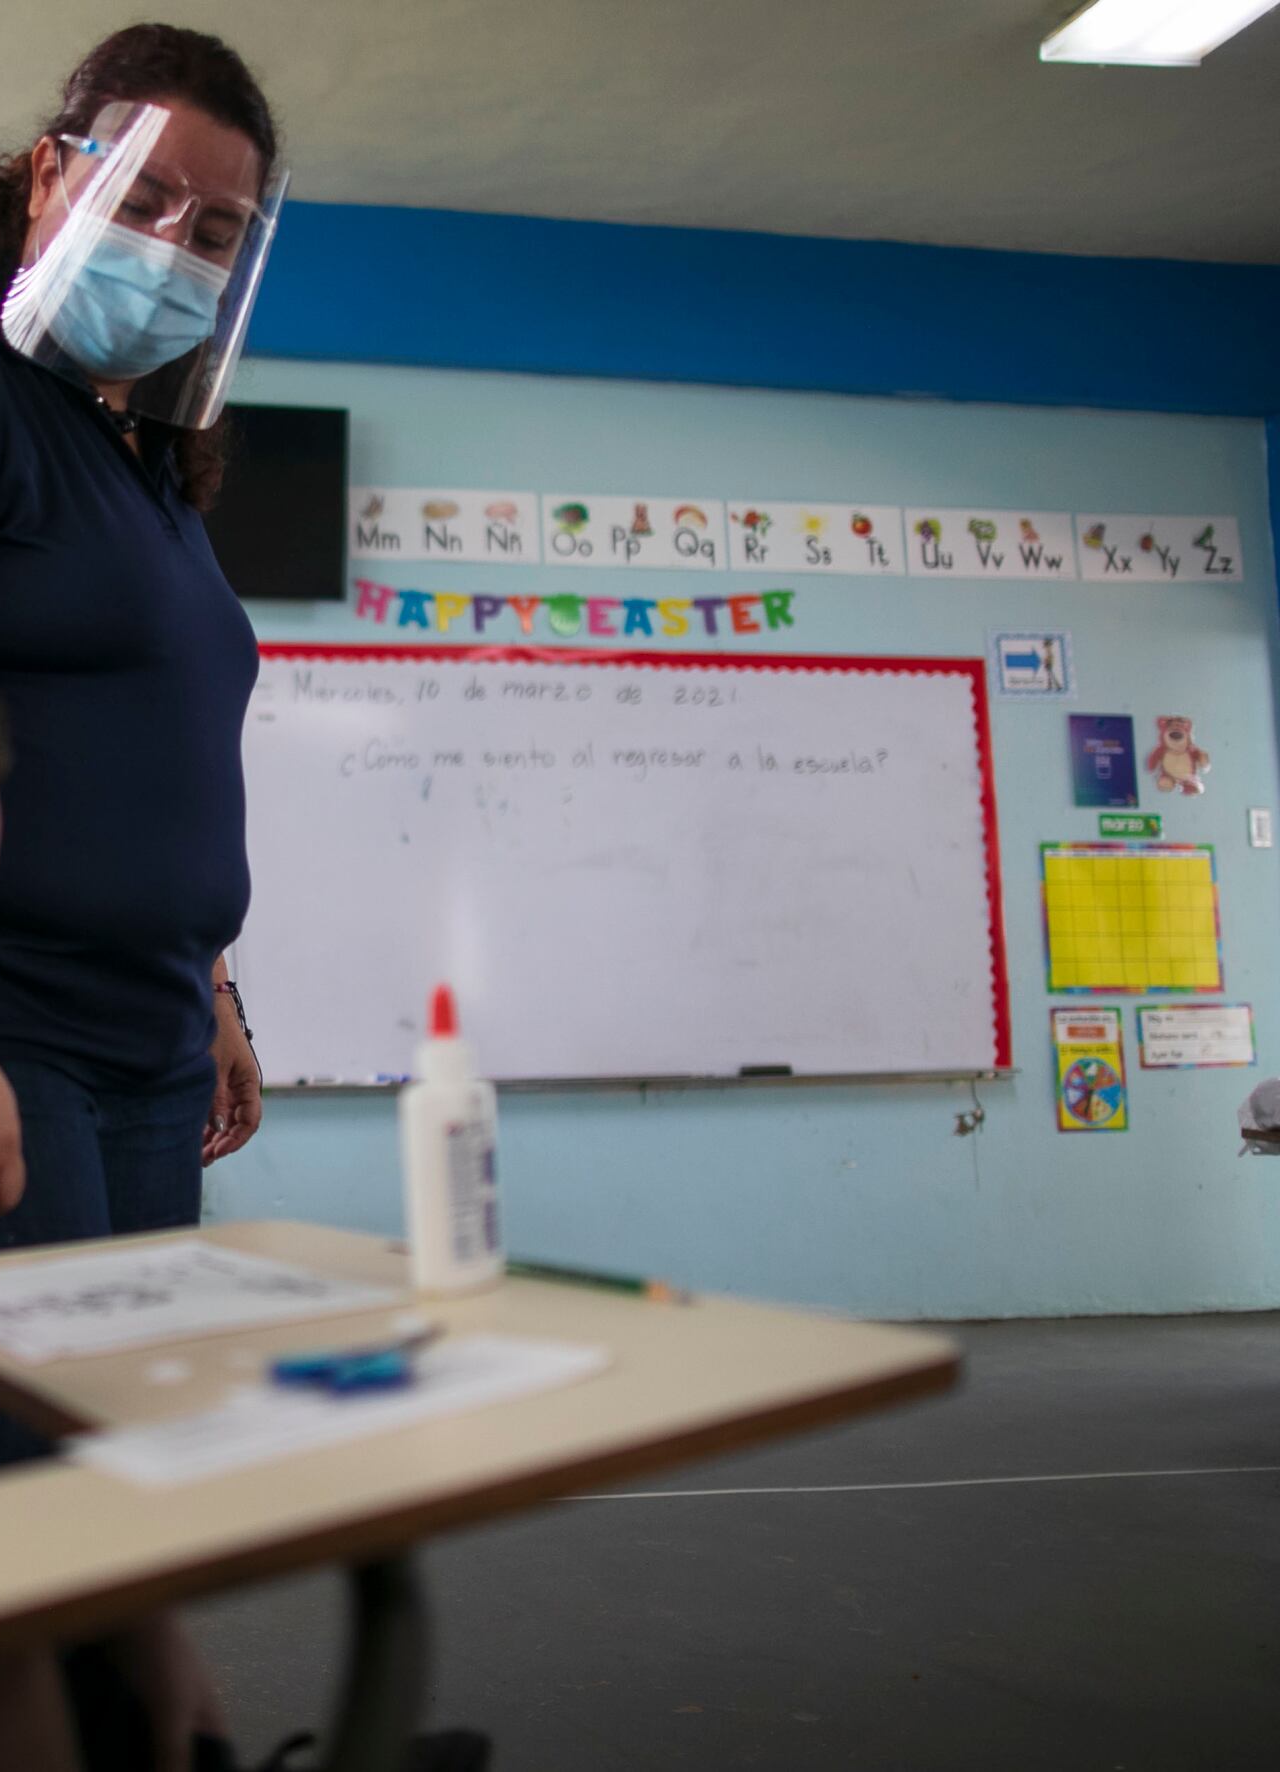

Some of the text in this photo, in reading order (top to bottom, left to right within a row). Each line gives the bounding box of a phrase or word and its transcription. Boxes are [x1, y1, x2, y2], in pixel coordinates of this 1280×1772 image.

[356, 524, 401, 551] Mm
[425, 524, 462, 552] Nn
[552, 531, 593, 558] Oo
[612, 525, 642, 563] Pp
[674, 530, 717, 566] Qq
[744, 536, 770, 563] Rr
[806, 537, 832, 565] Ss
[866, 537, 889, 567] Tt
[921, 542, 954, 570] Uu
[976, 542, 1005, 570] Vv
[1019, 544, 1062, 571] Ww
[1104, 545, 1132, 572] Xx
[1155, 546, 1180, 578] Yy
[1204, 546, 1234, 574] Zz
[354, 578, 795, 636] HAPPY EASTER
[418, 679, 441, 702] 10
[464, 674, 487, 701] de
[503, 680, 592, 701] marzo
[616, 684, 643, 705] de
[433, 750, 464, 767] me
[482, 737, 555, 768] siento
[572, 740, 593, 768] al
[614, 750, 705, 781] regresar
[728, 752, 742, 770] a
[756, 741, 777, 771] la
